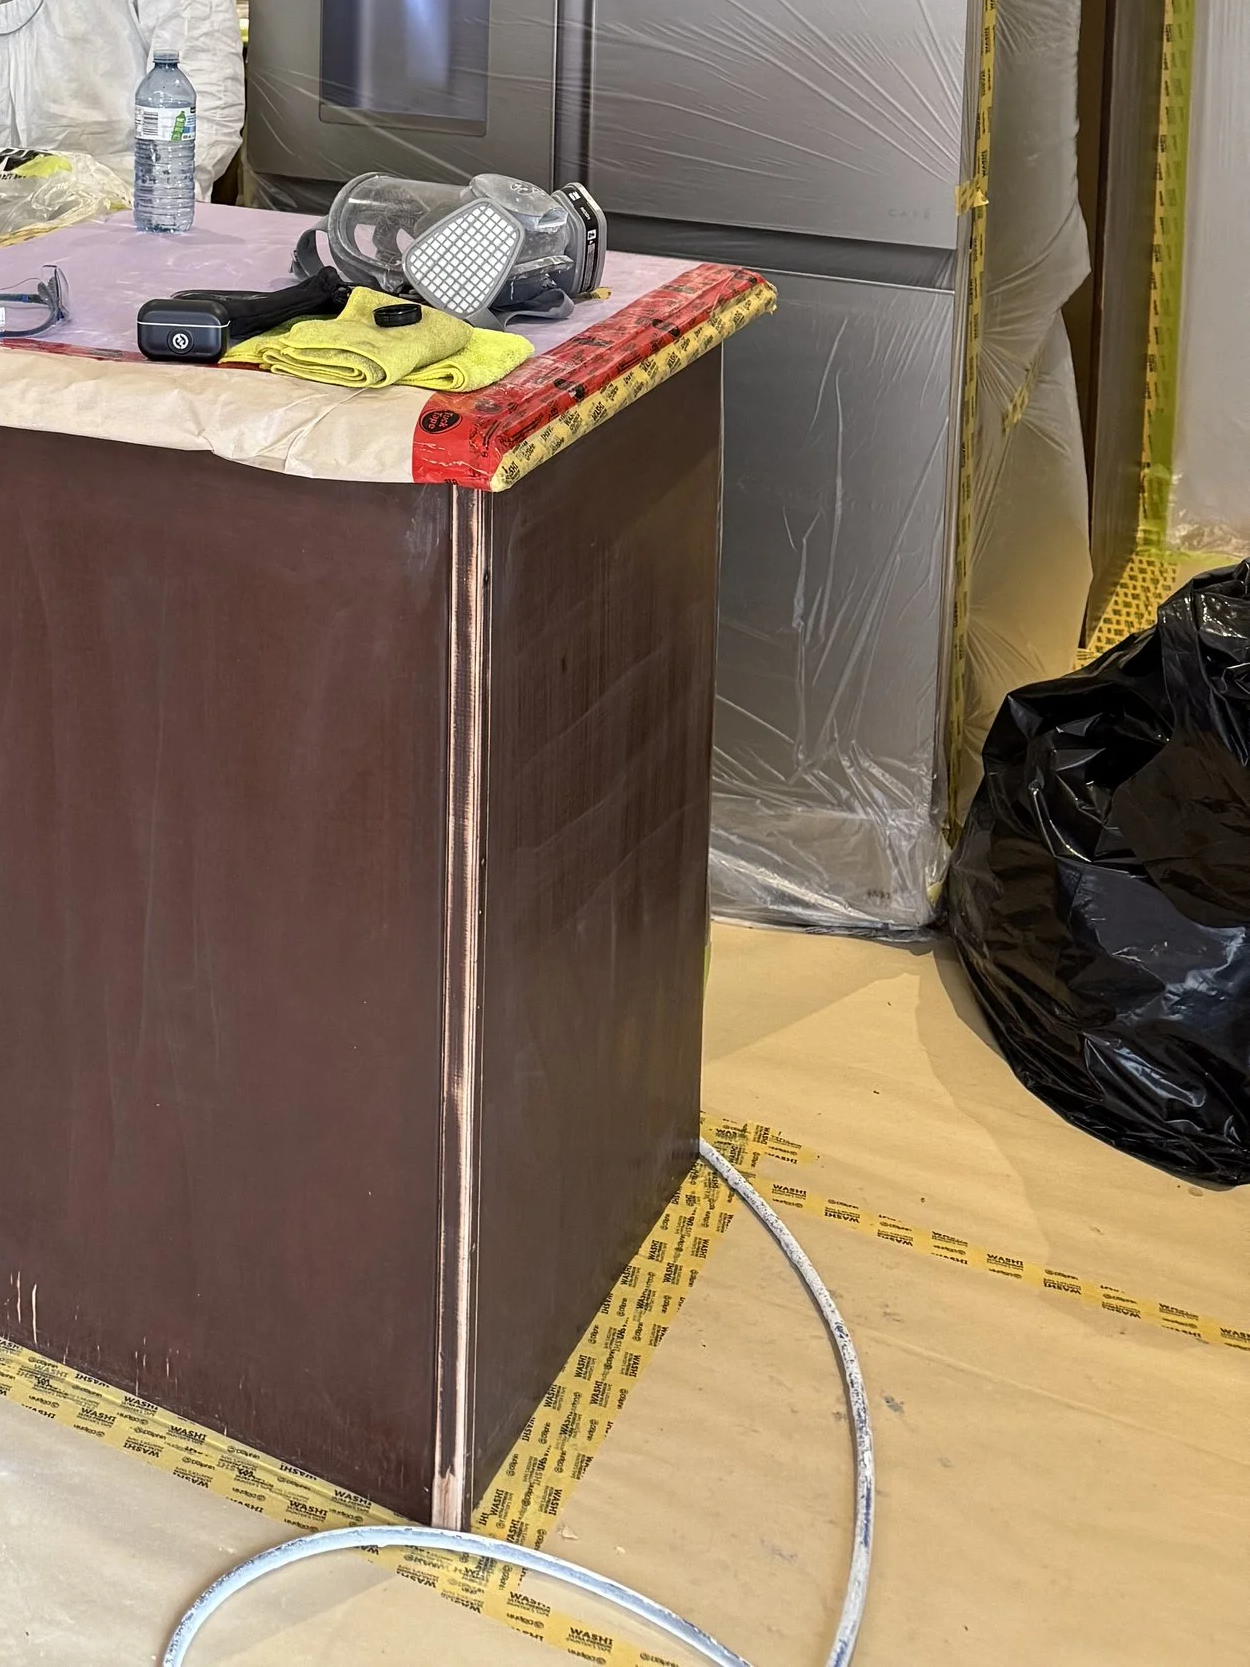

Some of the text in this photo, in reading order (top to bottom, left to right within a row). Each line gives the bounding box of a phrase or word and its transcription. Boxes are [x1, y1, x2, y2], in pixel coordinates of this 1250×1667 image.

[773, 1184, 807, 1196] WASHI
[824, 1211, 860, 1224] WASHI
[648, 1240, 659, 1260] WASHI
[699, 1239, 710, 1259] WASHI
[987, 1254, 1024, 1266] WASHI
[663, 1262, 675, 1283] WASHI
[1044, 1282, 1081, 1294] WASHI
[575, 1354, 587, 1378] WASHI
[629, 1354, 641, 1378] WASHI
[544, 1384, 557, 1408] WASHI
[590, 1380, 603, 1405] WASHI
[80, 1408, 116, 1424] WASHI
[170, 1425, 206, 1441] WASHI
[123, 1442, 159, 1458] WASHI
[289, 1500, 328, 1517] WASHI
[490, 1489, 504, 1516] WASHI
[548, 1489, 563, 1516] WASHI
[570, 1627, 612, 1645] WASHI
